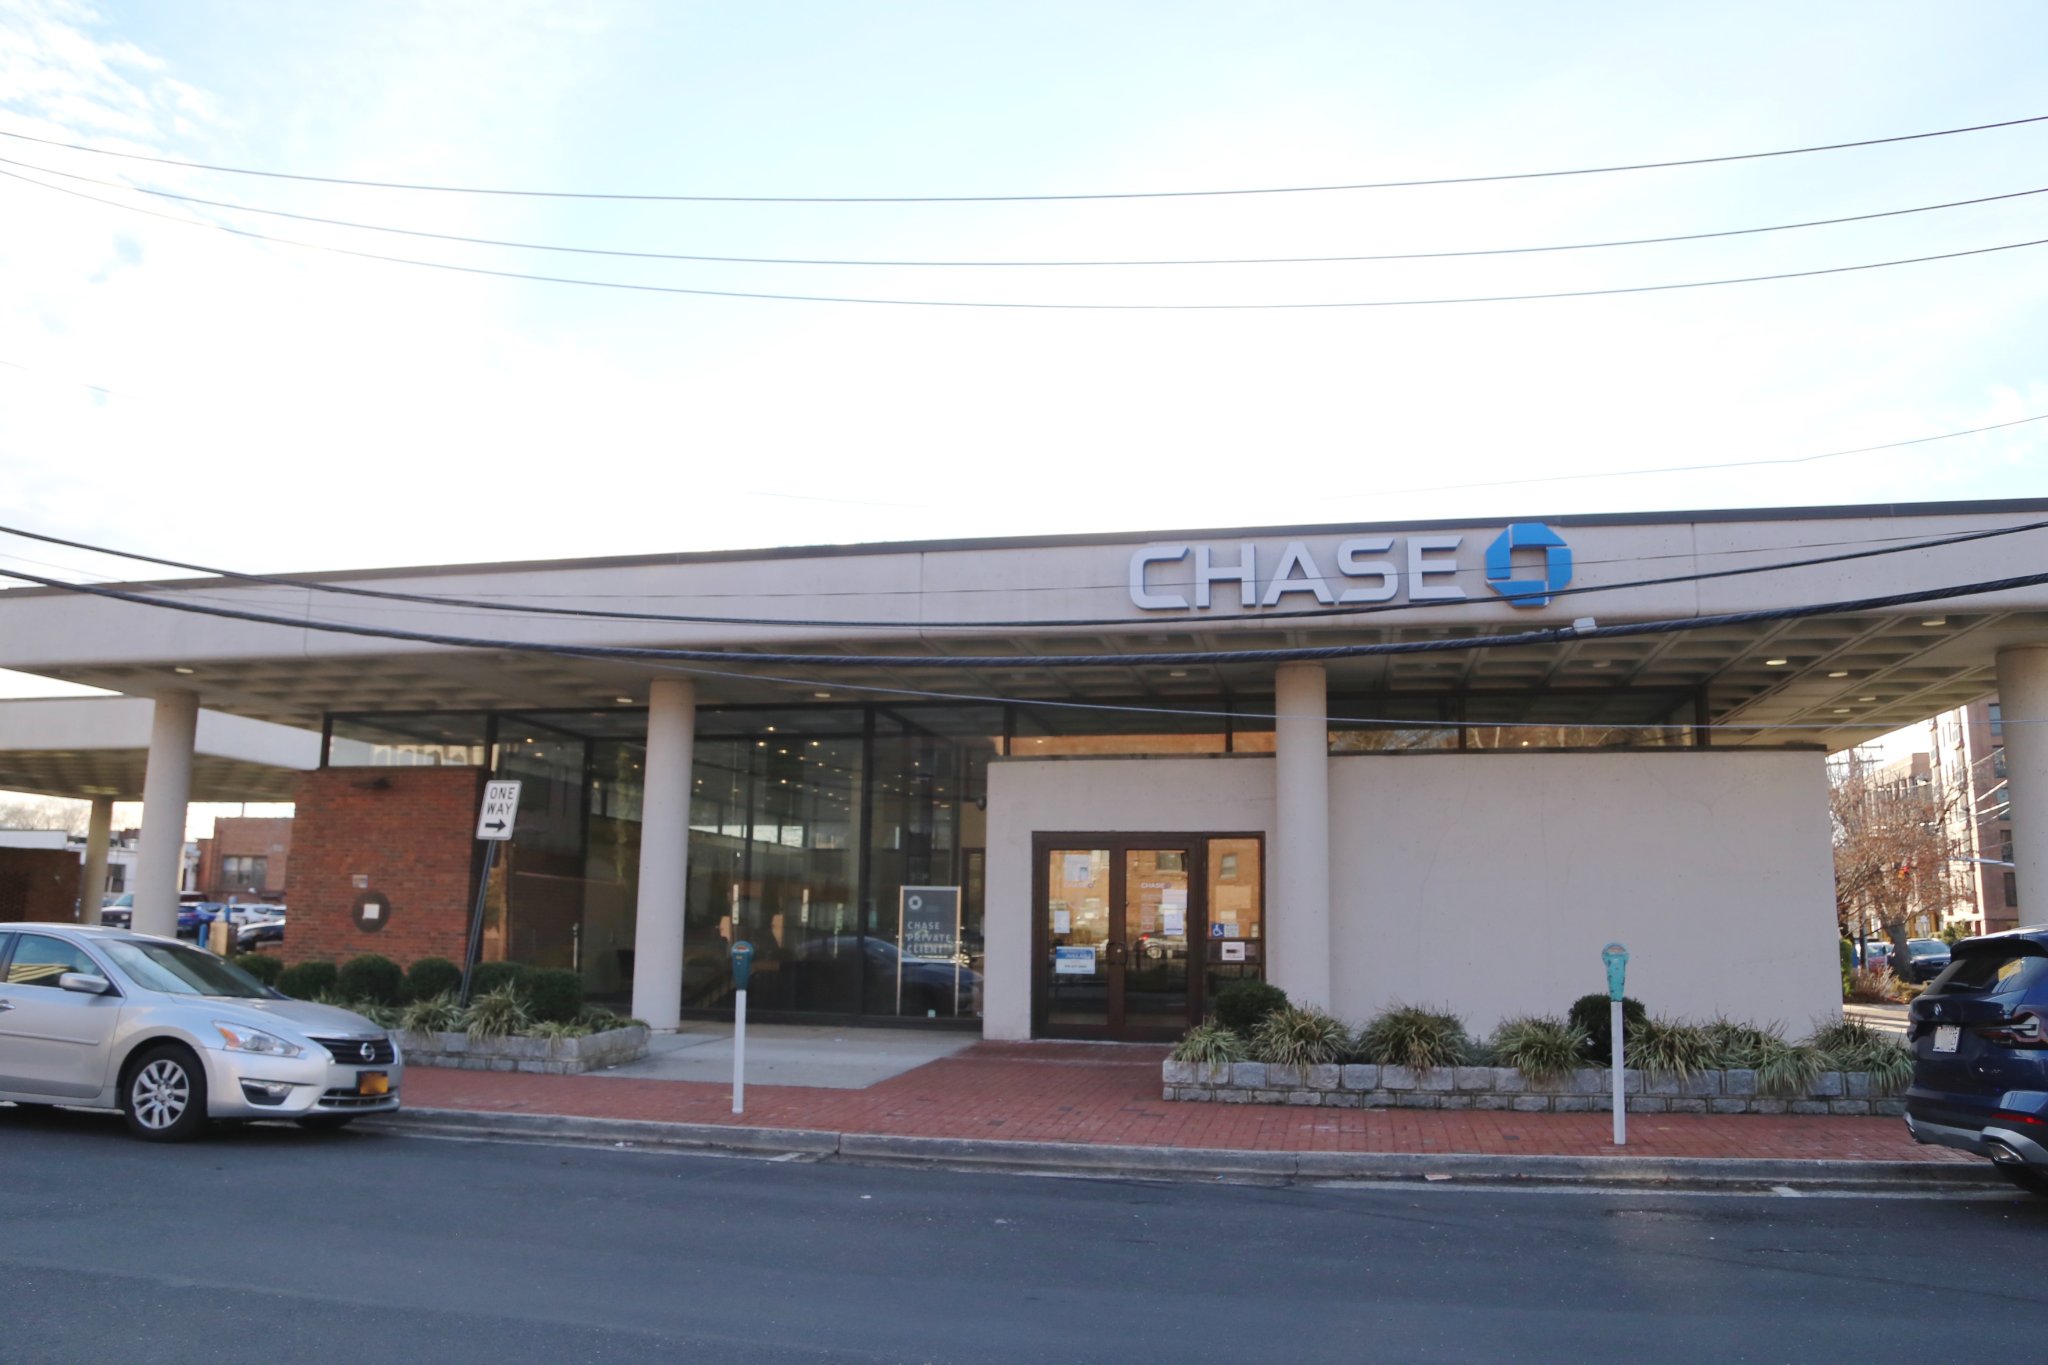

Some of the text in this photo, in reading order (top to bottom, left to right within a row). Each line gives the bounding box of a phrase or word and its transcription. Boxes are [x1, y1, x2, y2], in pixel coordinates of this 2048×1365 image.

[1128, 534, 1467, 611] CHASE
[490, 786, 516, 800] ONE
[486, 802, 514, 816] WAY
[906, 921, 940, 930] CHASE
[906, 933, 952, 942] PRIVATE
[906, 944, 943, 954] CLIENT
